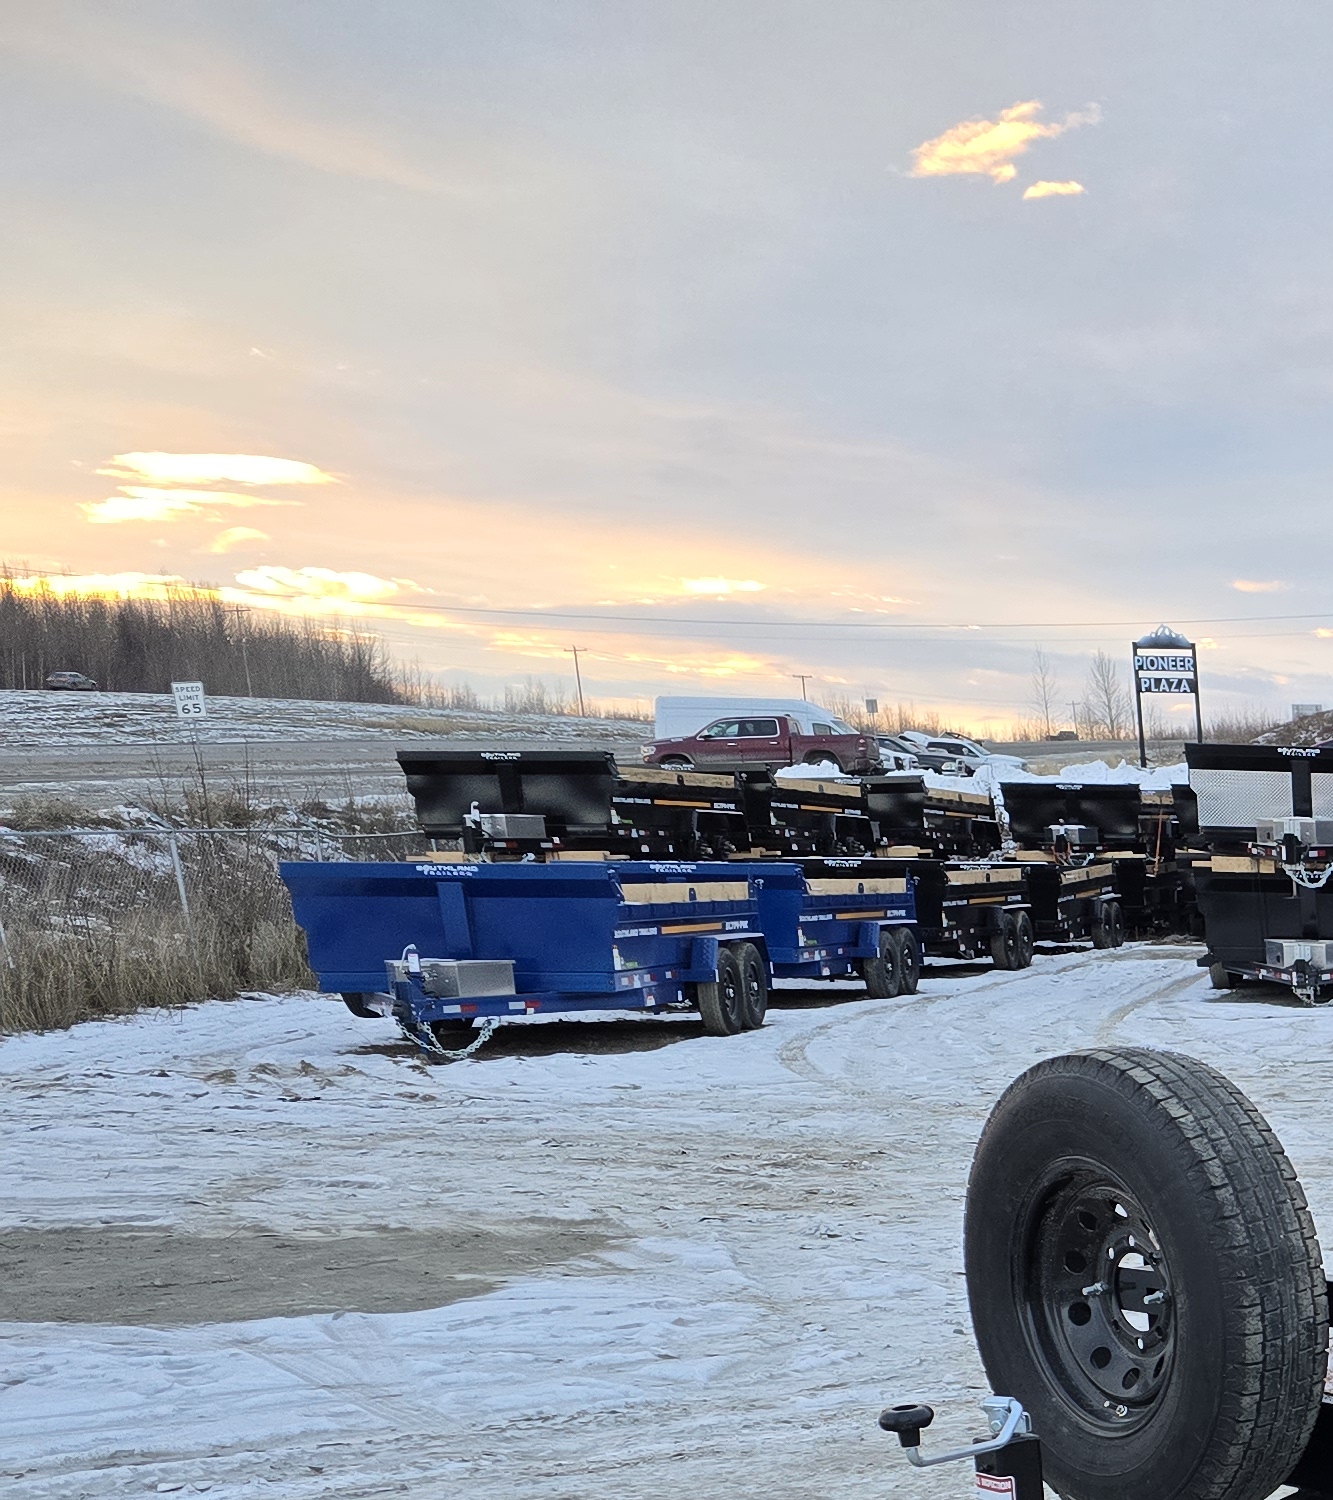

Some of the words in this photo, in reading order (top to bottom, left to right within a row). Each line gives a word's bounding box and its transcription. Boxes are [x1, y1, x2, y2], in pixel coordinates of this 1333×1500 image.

[1134, 656, 1194, 671] PIONEER
[1141, 678, 1190, 692] PLAZA
[182, 703, 201, 714] 65
